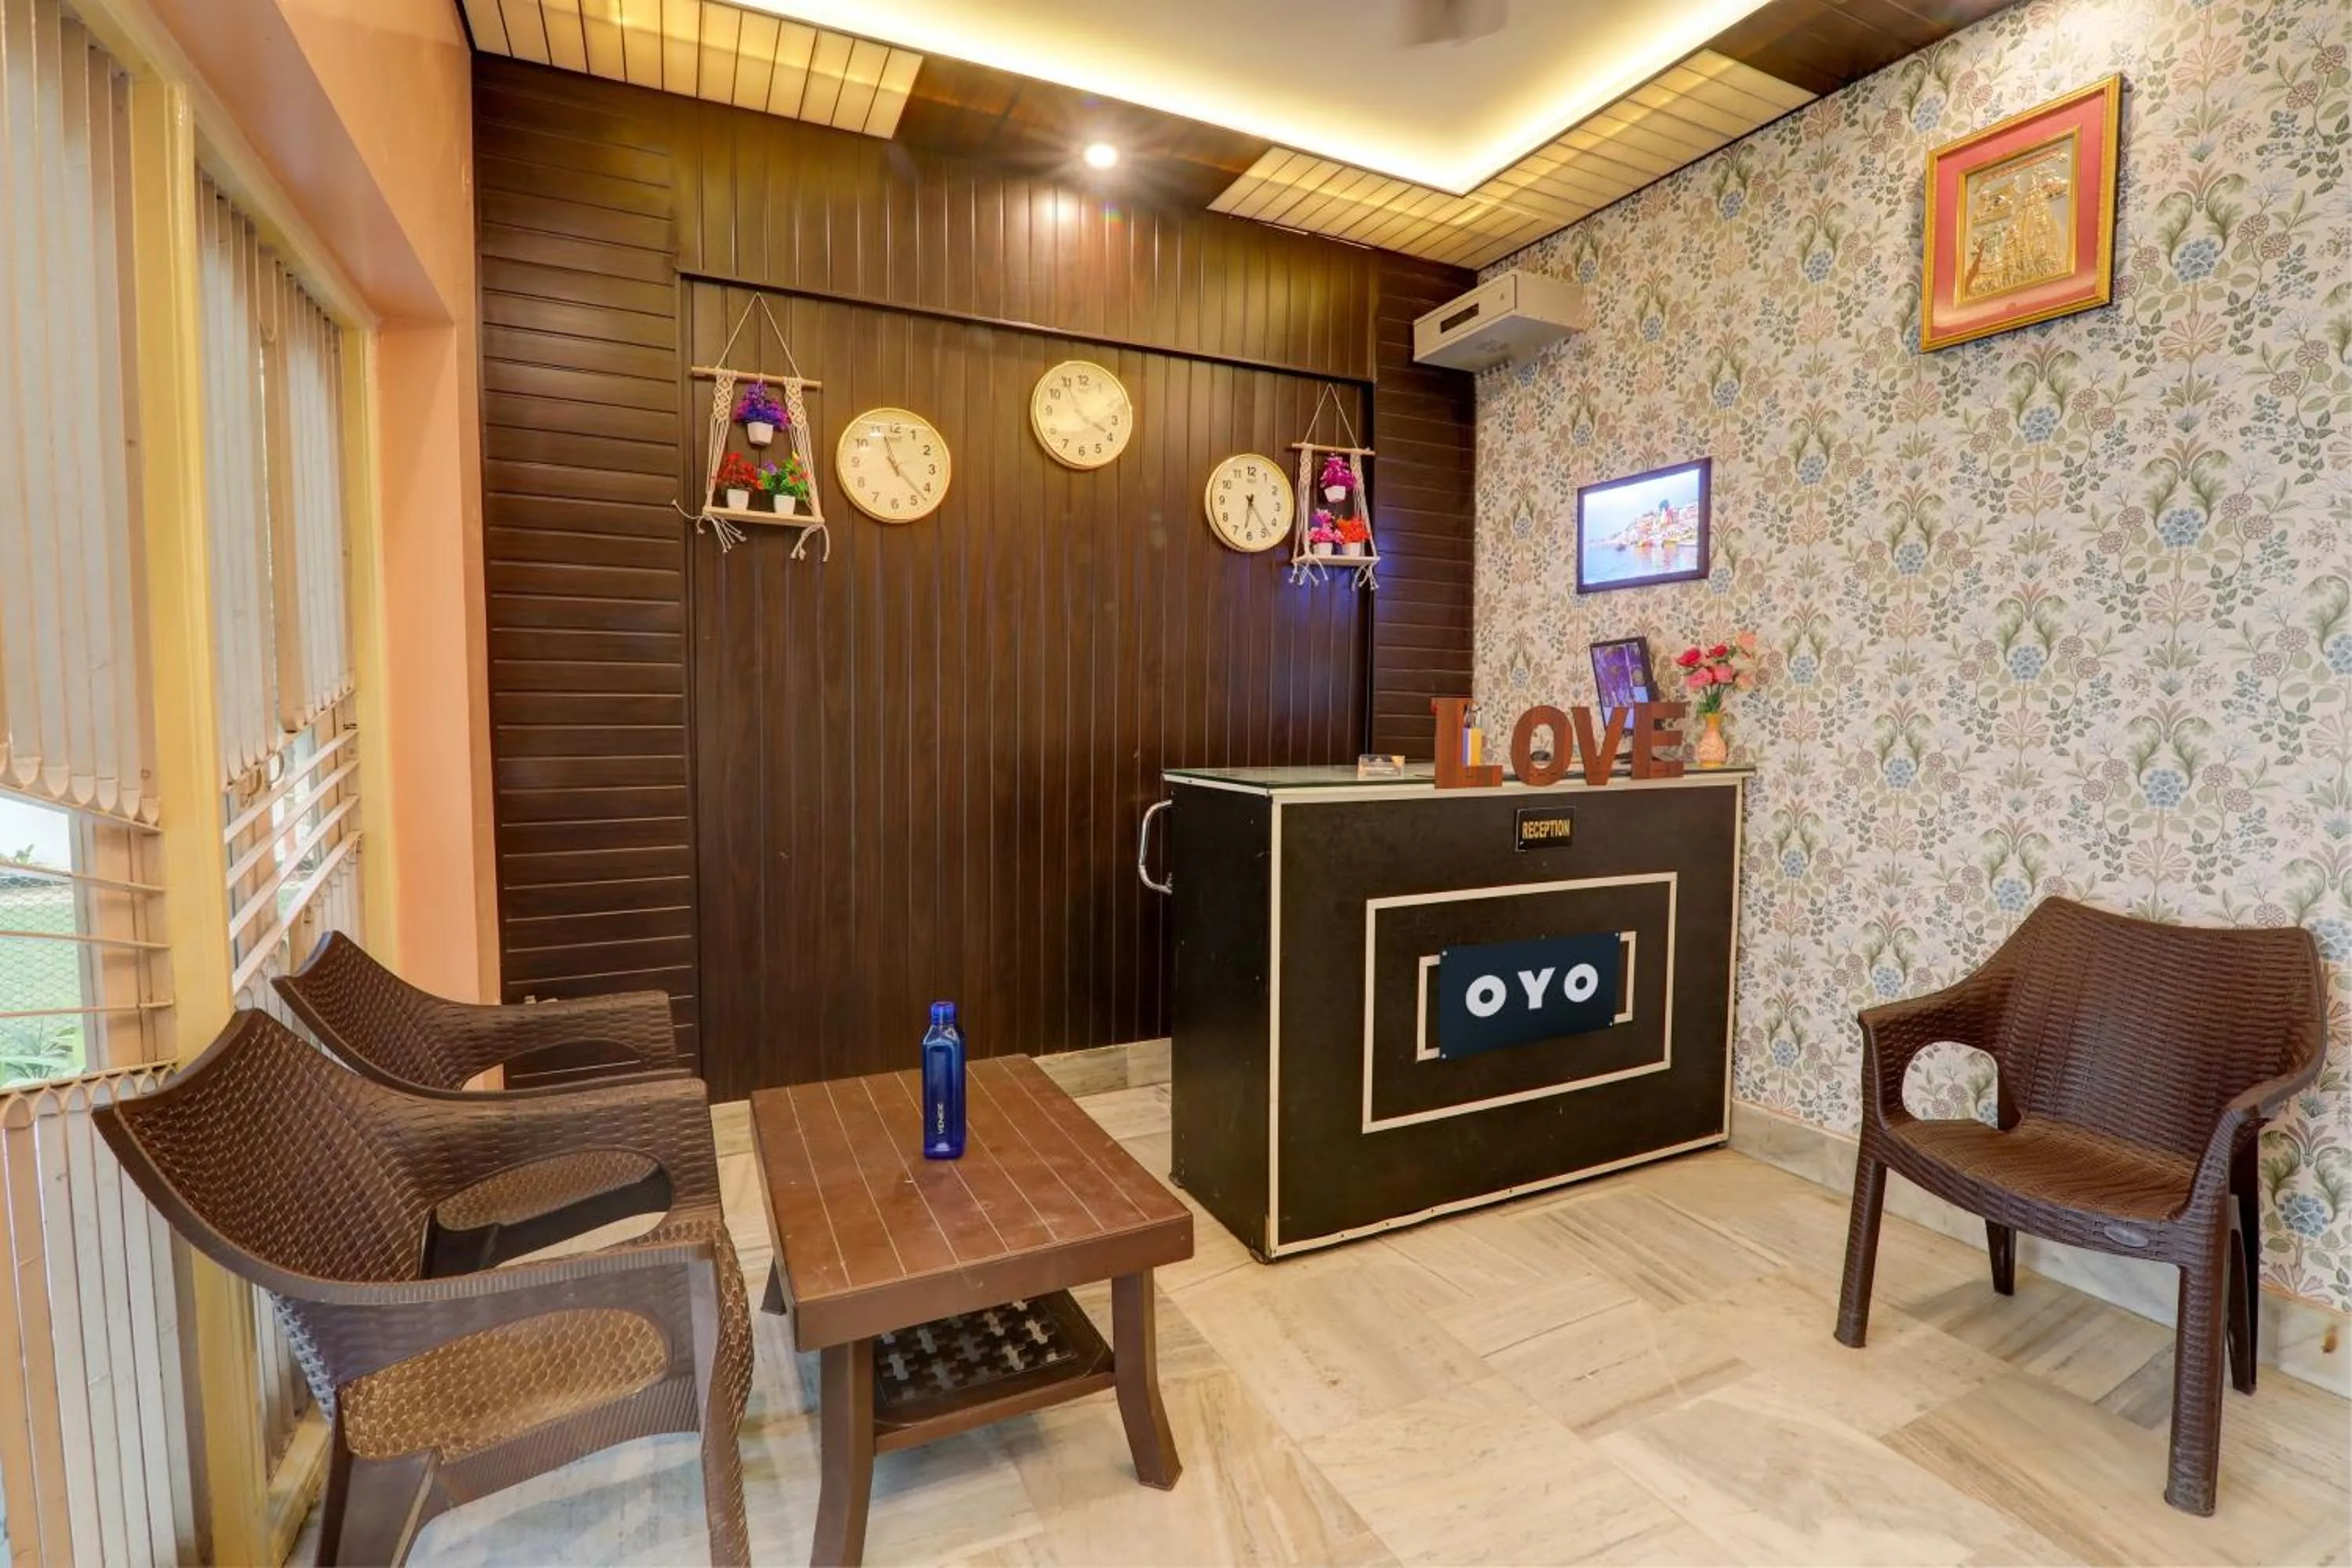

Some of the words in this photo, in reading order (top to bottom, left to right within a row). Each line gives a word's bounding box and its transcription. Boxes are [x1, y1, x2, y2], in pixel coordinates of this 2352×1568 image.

[1062, 376, 1072, 388] 11
[1078, 376, 1089, 386] 12
[1049, 388, 1061, 400] 10
[1045, 405, 1053, 416] 9
[1111, 416, 1118, 426] 3
[909, 430, 916, 441] 1
[1107, 432, 1113, 442] 4
[855, 438, 869, 448] 10
[1062, 439, 1069, 448] 7
[1094, 444, 1102, 453] 5
[923, 445, 931, 456] 2
[1078, 446, 1086, 456] 6
[851, 456, 860, 468] 9
[928, 463, 936, 475] 3
[1233, 470, 1242, 478] 11
[1247, 466, 1256, 477] 12
[857, 477, 866, 488] 8
[1263, 473, 1268, 482] 1
[923, 482, 931, 494] 4
[1222, 480, 1232, 490] 10
[1272, 486, 1278, 495] 2
[871, 492, 879, 503] 7
[910, 495, 918, 506] 5
[1218, 495, 1225, 505] 9
[891, 498, 899, 509] 6
[1275, 503, 1280, 511] 3
[1222, 513, 1229, 521] 8
[1232, 524, 1239, 535] 7
[1260, 528, 1266, 538] 5
[1246, 532, 1253, 541] 6
[1432, 698, 1689, 789] LOVE
[1523, 818, 1570, 840] RECEPTION
[1465, 963, 1599, 1018] OYO
